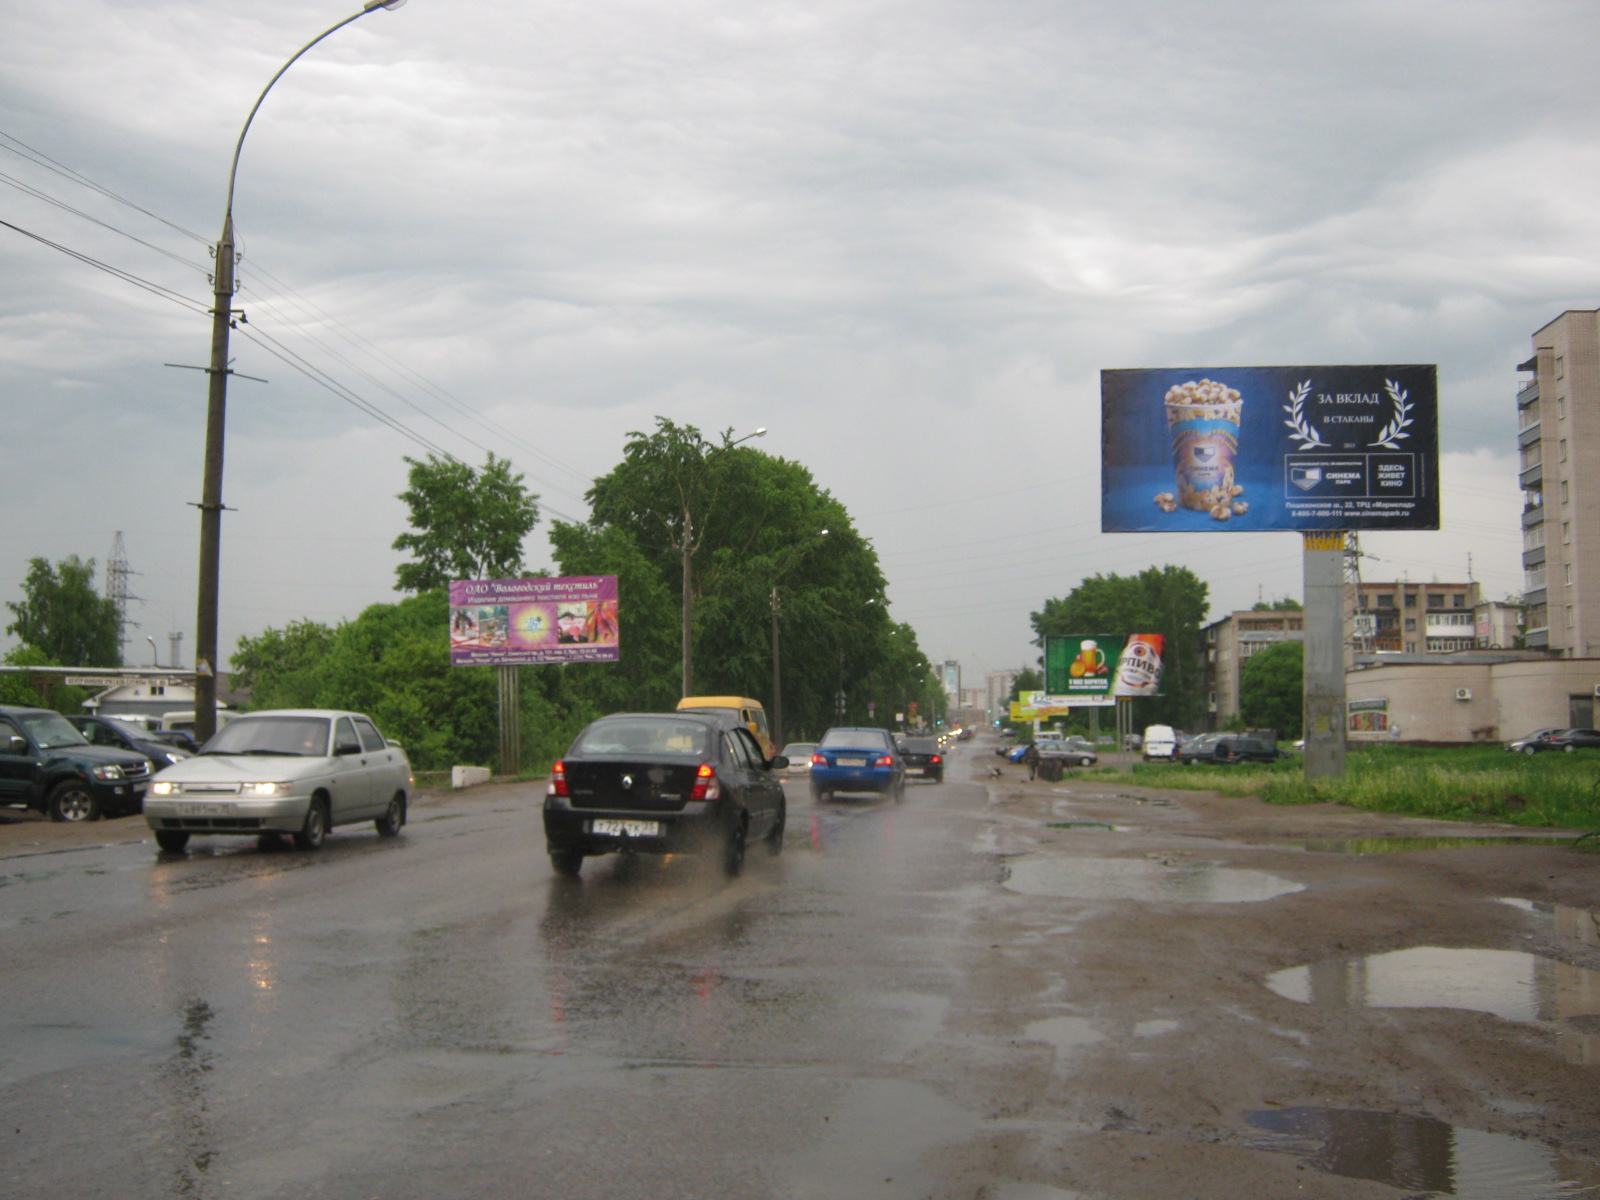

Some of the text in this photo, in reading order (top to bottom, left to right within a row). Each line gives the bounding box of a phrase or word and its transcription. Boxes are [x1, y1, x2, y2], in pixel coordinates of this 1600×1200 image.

[1317, 393, 1380, 405] ЗА ВКЛАД
[1323, 415, 1375, 424] В СТАКАНЫ
[1378, 464, 1405, 472] ЗДЕСЬ
[1377, 472, 1406, 480] ЖИВЕТ
[1356, 501, 1371, 509] ТРЦ
[465, 584, 489, 595] ОАО
